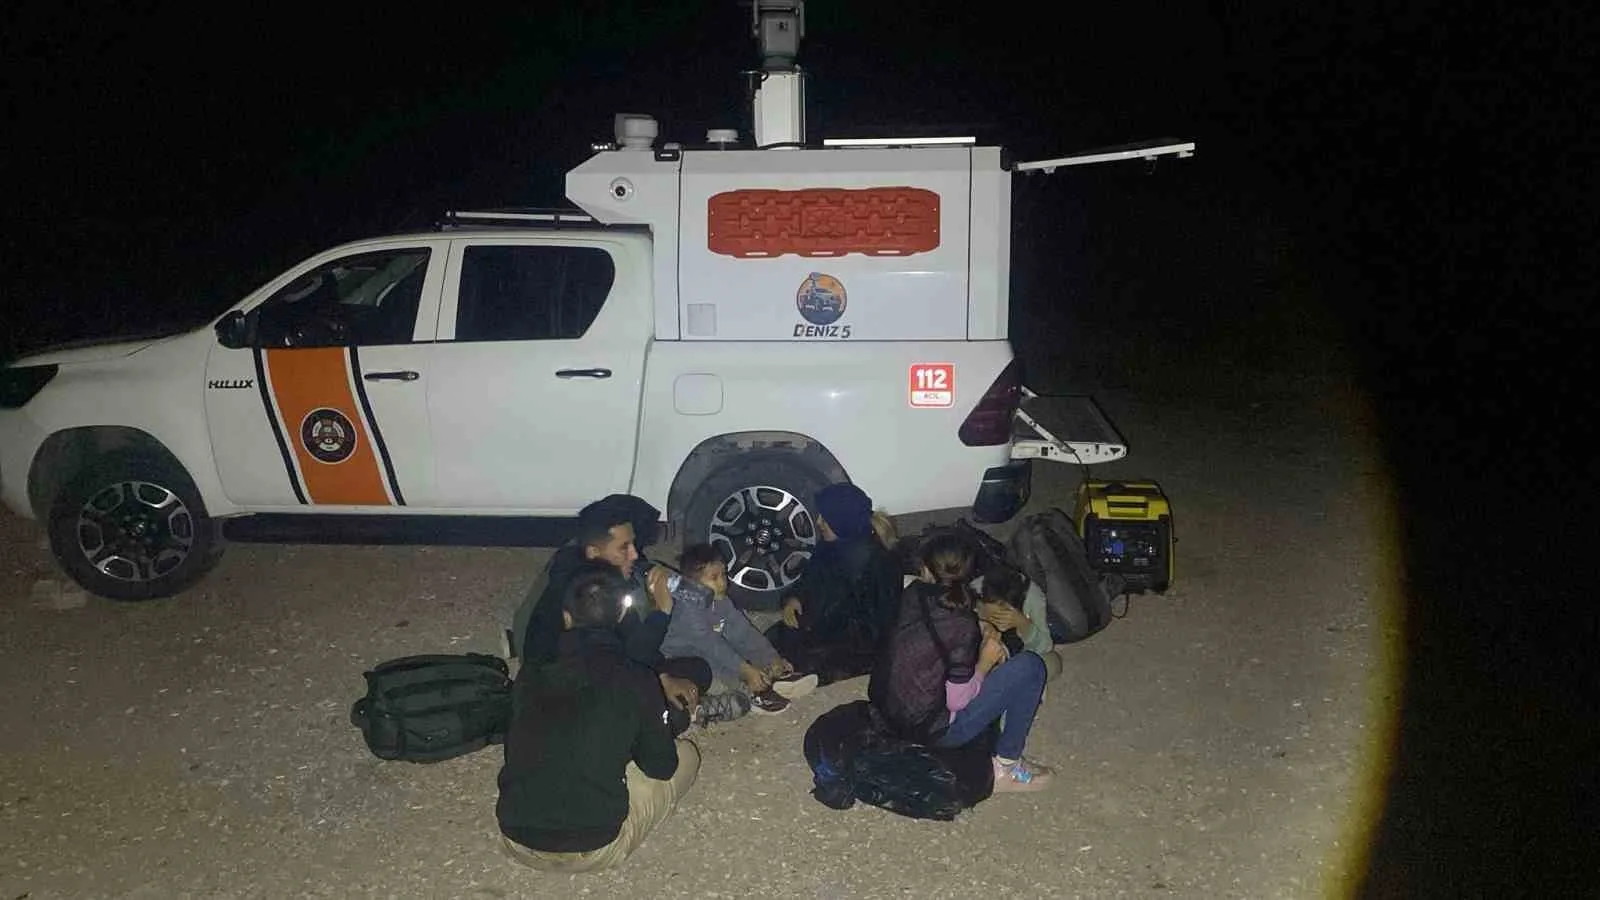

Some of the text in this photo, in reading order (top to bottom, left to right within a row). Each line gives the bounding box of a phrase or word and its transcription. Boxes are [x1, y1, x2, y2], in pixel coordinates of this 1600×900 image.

[840, 325, 851, 338] 5
[208, 379, 253, 389] HILUX
[916, 368, 947, 389] 112
